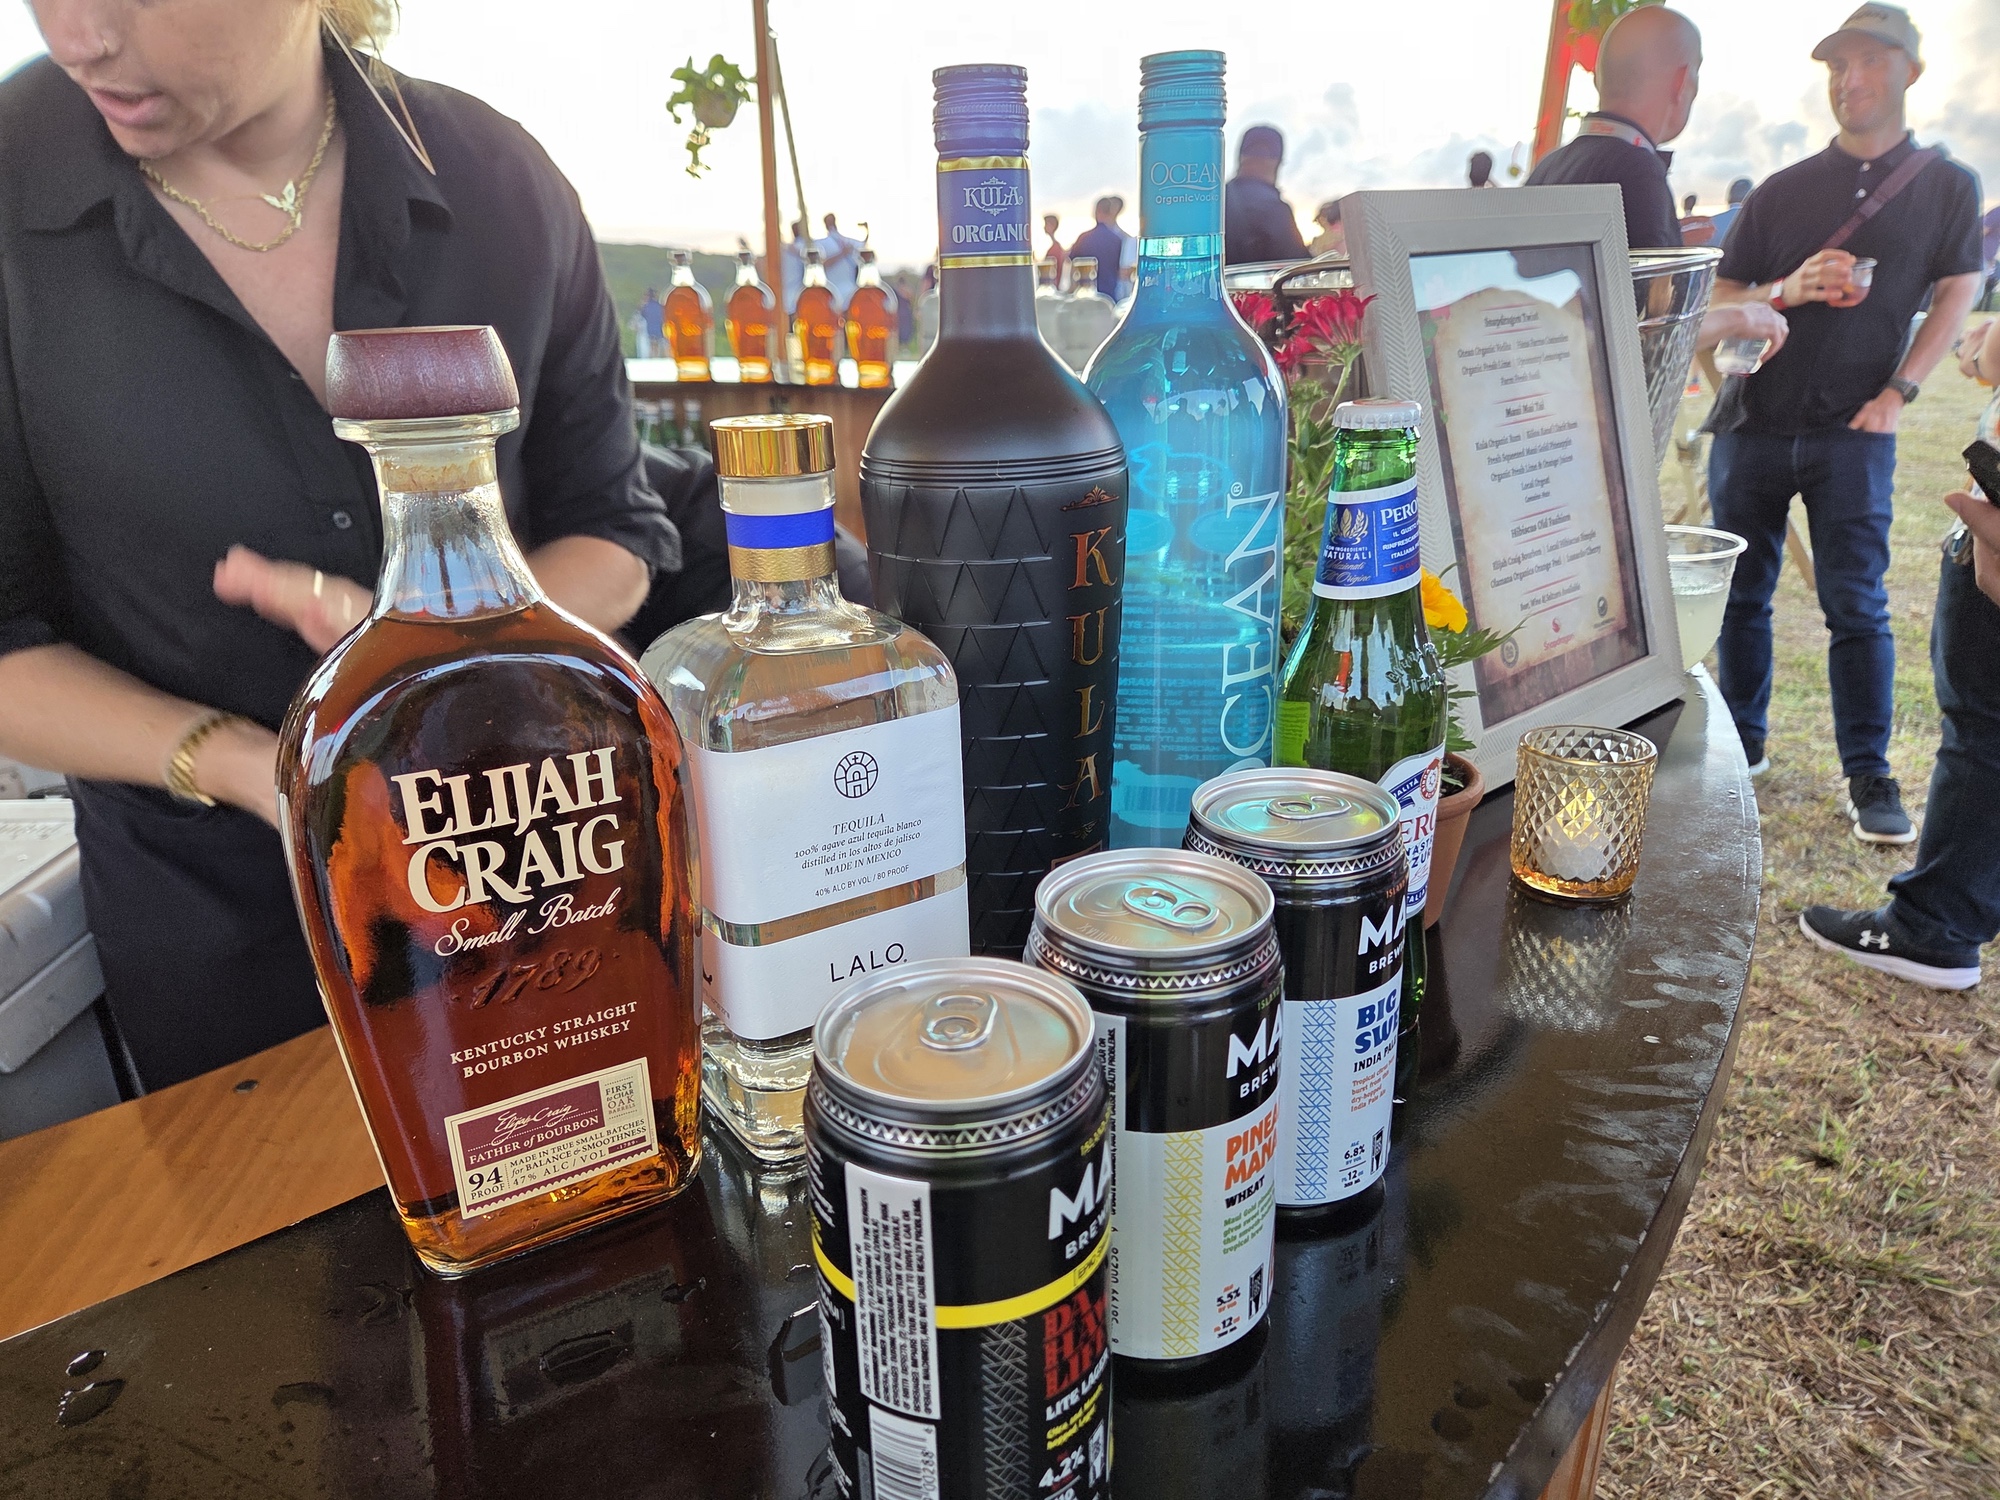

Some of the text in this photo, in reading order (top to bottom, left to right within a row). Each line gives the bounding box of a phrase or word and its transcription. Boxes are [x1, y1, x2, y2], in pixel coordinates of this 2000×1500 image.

[962, 185, 1022, 208] KULA
[1505, 400, 1545, 418] Maui Mai Tai
[1488, 436, 1508, 450] Organic
[1486, 455, 1502, 466] Fresh
[1502, 448, 1525, 463] Squeezed
[1490, 470, 1511, 483] Organic
[1512, 464, 1525, 476] Fresh
[1525, 462, 1538, 472] Lime
[1520, 479, 1534, 491] Local
[1380, 497, 1419, 526] PERO
[1510, 524, 1537, 539] Hibiscus
[1537, 518, 1548, 530] Old
[1323, 549, 1372, 561] NATURALI
[1492, 560, 1508, 571] Elijah
[1508, 556, 1521, 565] Craig
[1521, 548, 1542, 561] Bourbon
[1513, 568, 1534, 582] Organics
[1534, 560, 1552, 574] Orange
[390, 746, 622, 844] ELIJAH
[832, 813, 886, 836] TEQUILA
[794, 818, 923, 859] 100% agave azul tequila blanco
[801, 830, 922, 870] distilled in los altos de jalisco
[407, 814, 625, 913] CRAIG
[824, 848, 902, 877] MADE IN MEXICO
[814, 886, 830, 898] 40%
[832, 882, 846, 894] ALC
[847, 880, 857, 890] BY
[857, 875, 872, 887] VOL
[876, 870, 886, 881] 80
[886, 864, 910, 878] PROOF
[434, 886, 622, 957] Small Batch
[1358, 895, 1406, 956] MA
[1368, 939, 1405, 974] BREW
[1356, 988, 1397, 1030] BIG
[450, 1001, 638, 1064] KENTUCKY STRAIGHT
[1226, 1003, 1283, 1079] MA
[463, 1019, 631, 1078] BOURBON WHISKEY
[1354, 1051, 1382, 1073] INDIA
[606, 1081, 634, 1096] FIRST
[1352, 1072, 1376, 1087] Tropical
[1352, 1084, 1368, 1096] burst
[608, 1094, 635, 1109] OAK
[614, 1089, 634, 1100] CHAR
[1350, 1093, 1379, 1112] India Pale
[608, 1103, 636, 1114] BARRELS
[469, 1115, 600, 1165] FATHER of BOURBON
[510, 1118, 645, 1168] MADE IN TRUE SMALL BATCHES
[510, 1165, 524, 1178] for
[525, 1151, 572, 1171] BALANCE
[582, 1125, 648, 1152] SMOOTHNESS
[1344, 1144, 1366, 1160] 6.8%
[468, 1166, 502, 1192] 94
[513, 1172, 538, 1187] 47%
[1348, 1170, 1358, 1180] 12
[470, 1183, 506, 1200] PROOF
[1048, 1139, 1112, 1240] MA
[1224, 1174, 1266, 1209] WHEAT
[1224, 1202, 1257, 1227] Maui Gold
[1222, 1234, 1237, 1246] this
[1223, 1223, 1241, 1238] gives
[1222, 1234, 1250, 1255] tropical
[1216, 1286, 1241, 1307] 5.5%
[1221, 1316, 1233, 1329] 12
[1046, 1386, 1080, 1422] LITE
[1038, 1444, 1086, 1488] 4.2%
